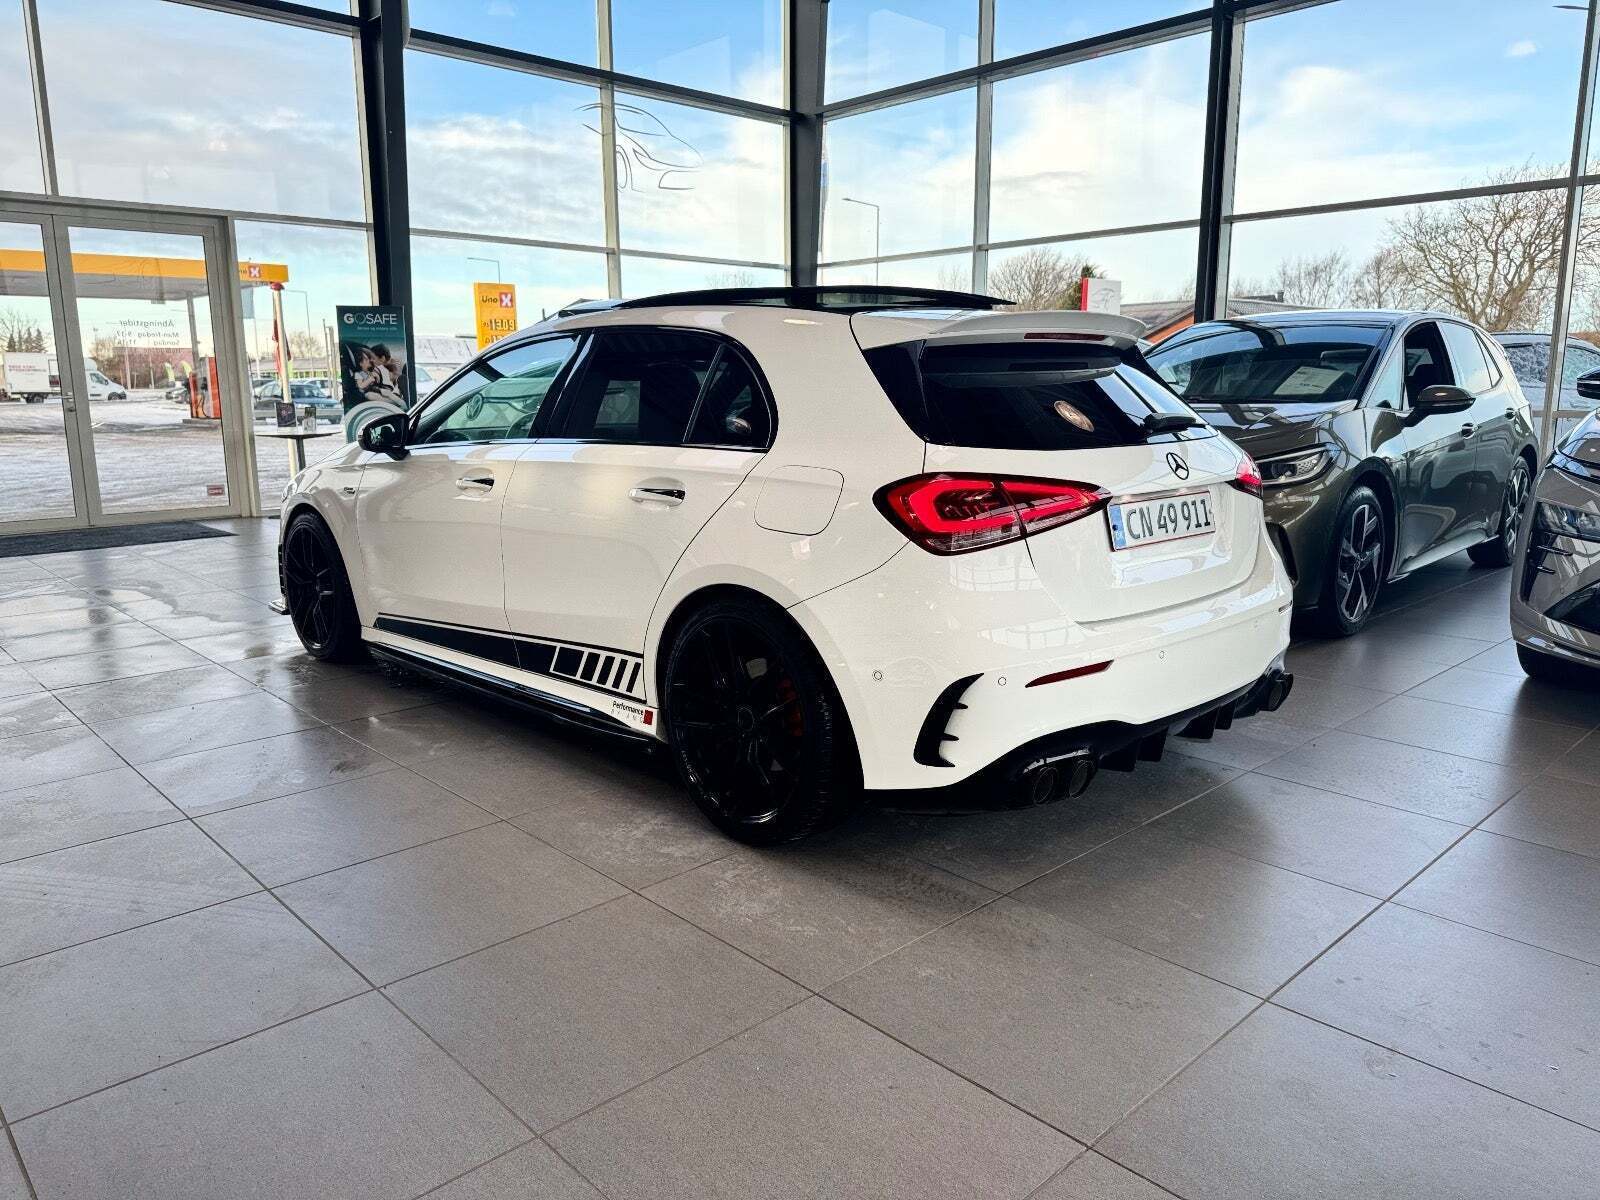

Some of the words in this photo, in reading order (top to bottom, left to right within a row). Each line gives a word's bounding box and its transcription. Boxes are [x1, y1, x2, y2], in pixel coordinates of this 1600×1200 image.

[481, 295, 498, 304] Uno
[343, 312, 398, 325] GOSAFE
[1127, 506, 1154, 540] CN
[1157, 503, 1178, 534] 49
[1181, 499, 1211, 531] 911
[612, 700, 644, 715] Performance
